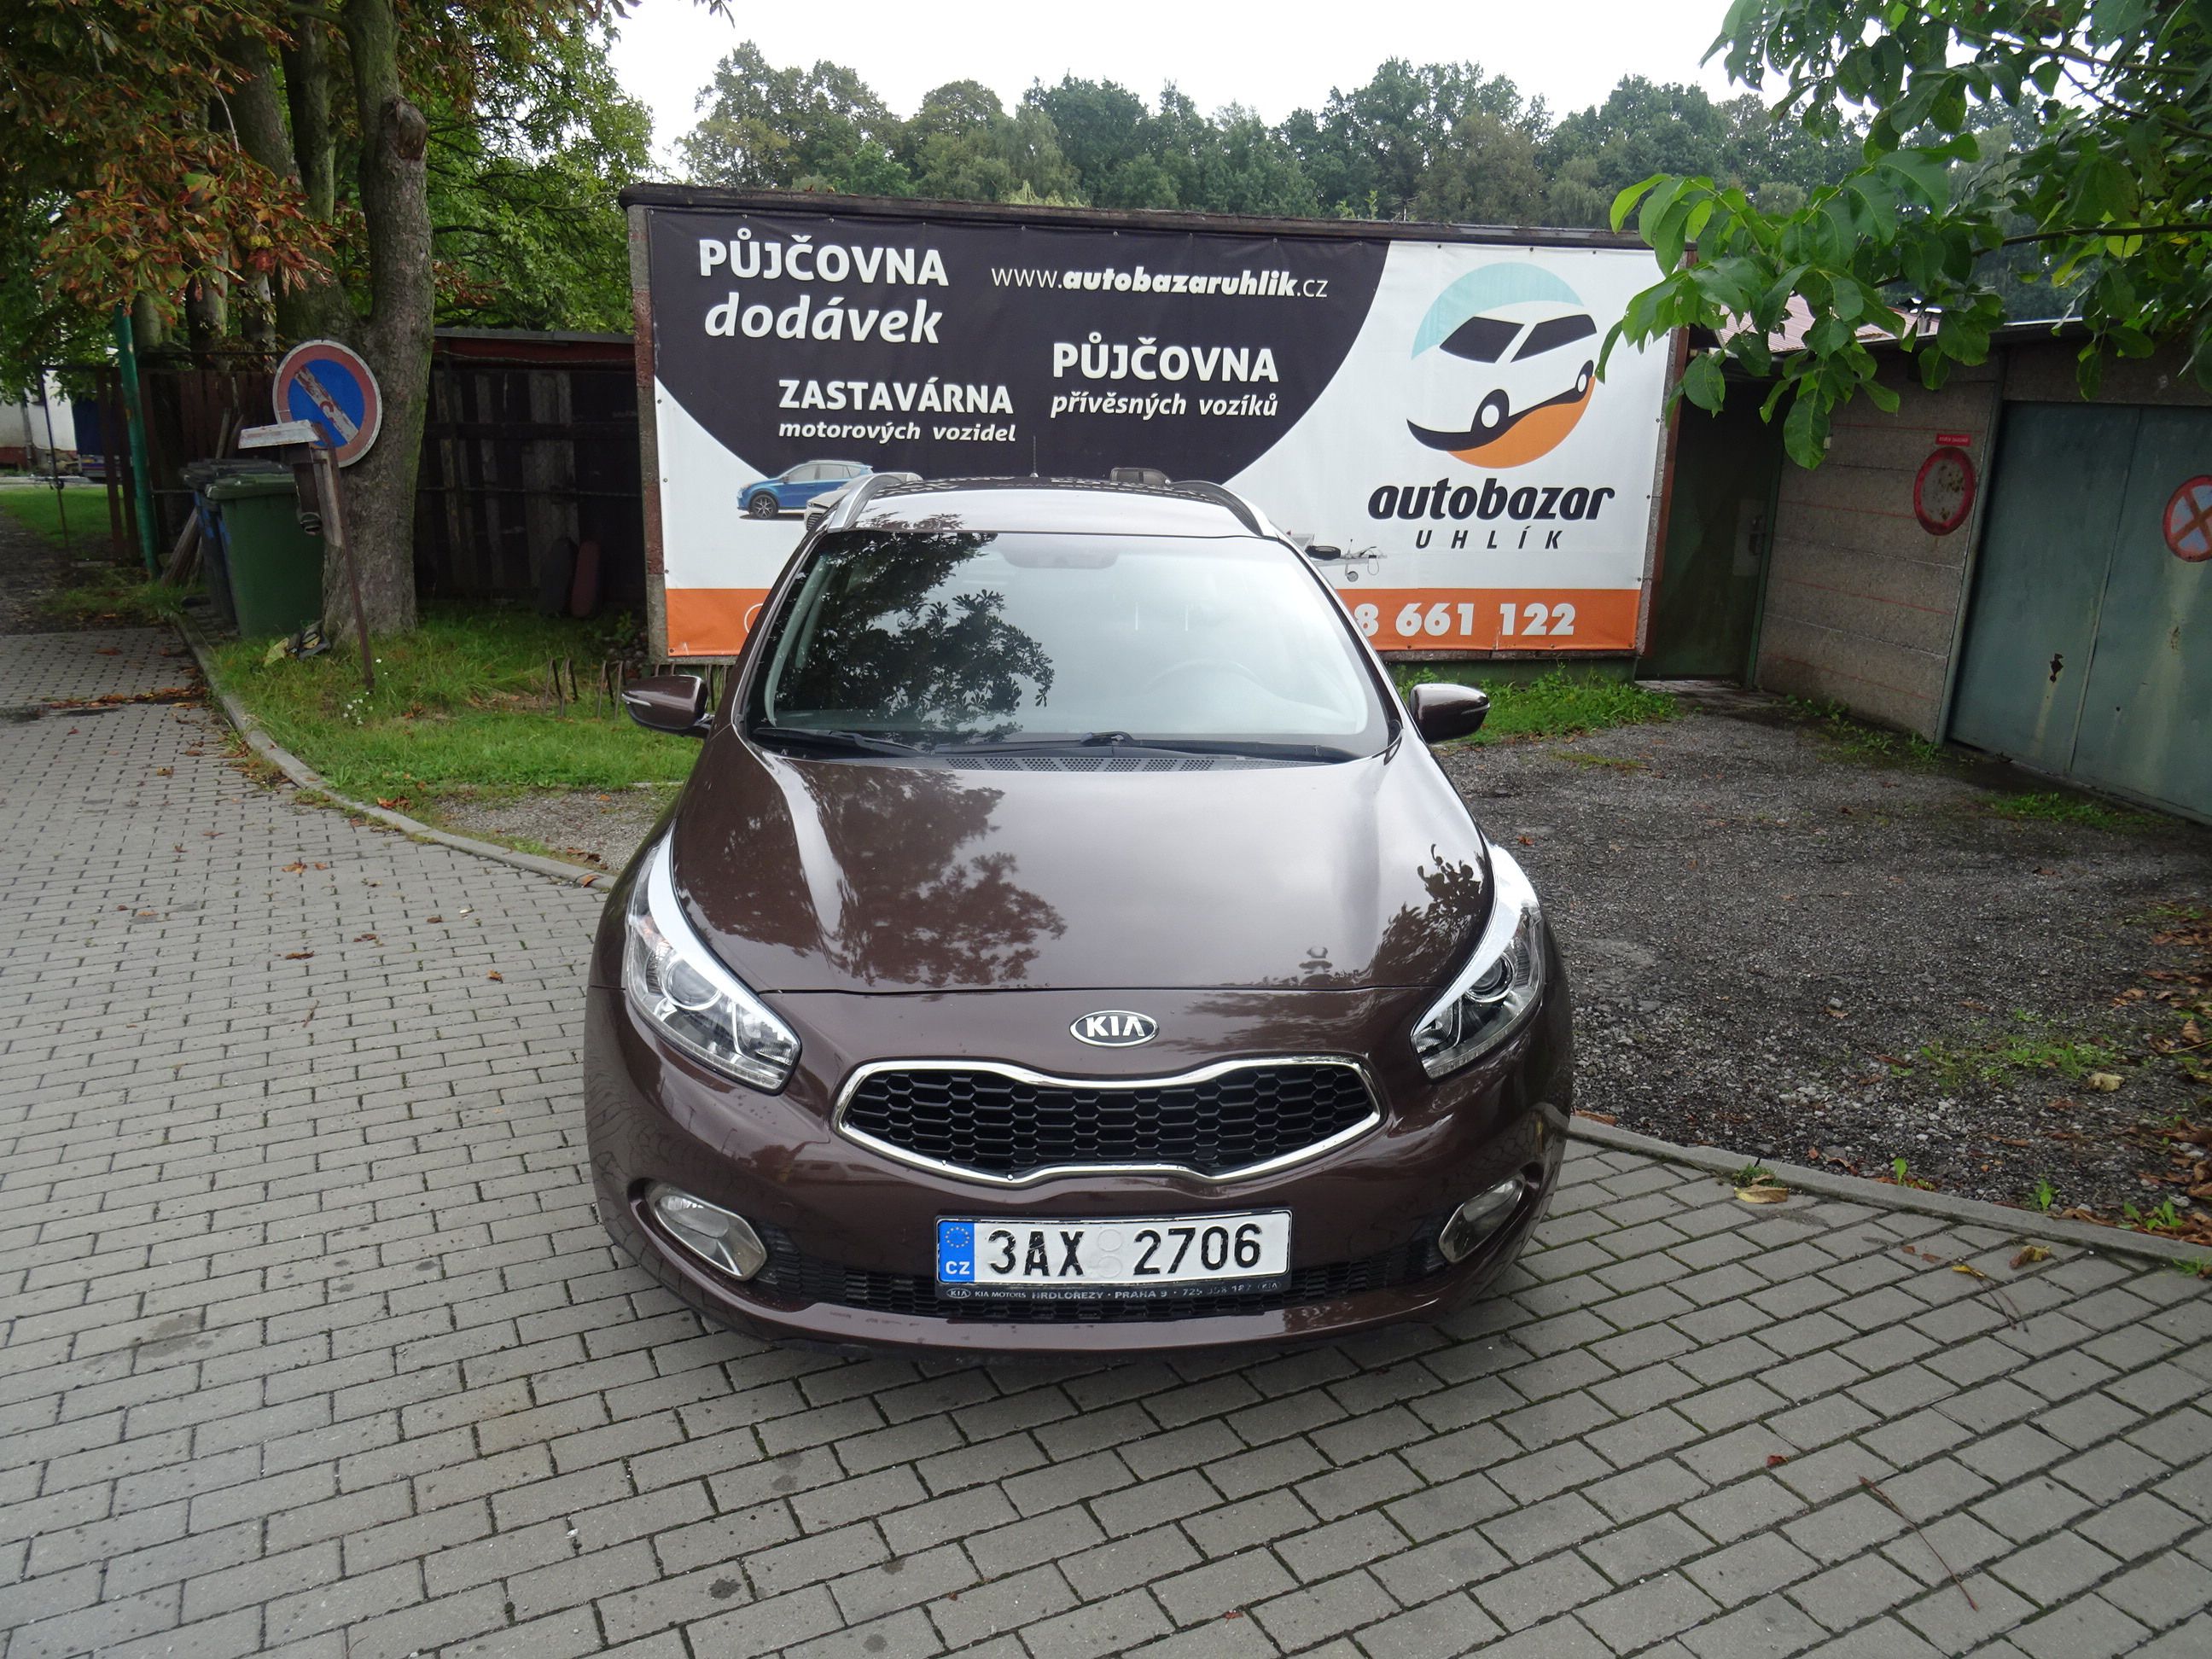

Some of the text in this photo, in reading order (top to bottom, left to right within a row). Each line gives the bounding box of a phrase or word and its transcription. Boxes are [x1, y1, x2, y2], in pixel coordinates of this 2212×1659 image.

[699, 227, 949, 287] PŮJČOVNA
[991, 265, 1329, 298] www.autobazaruhlik.cz
[704, 291, 943, 344] dodávek
[1053, 331, 1279, 382] PŮJČOVNA
[778, 376, 1014, 414] ZASTAVÁRNA
[1050, 391, 1278, 421] přívěsných vozíků
[778, 421, 1016, 445] motorových vozidel
[1368, 478, 1615, 521] autobazar
[1395, 602, 1475, 637] 661
[1499, 602, 1576, 636] 122
[1086, 1016, 1145, 1037] KIA
[987, 1222, 1263, 1277] 3AX 2706
[946, 1260, 970, 1275] CZ
[1115, 1289, 1156, 1299] PRAHA
